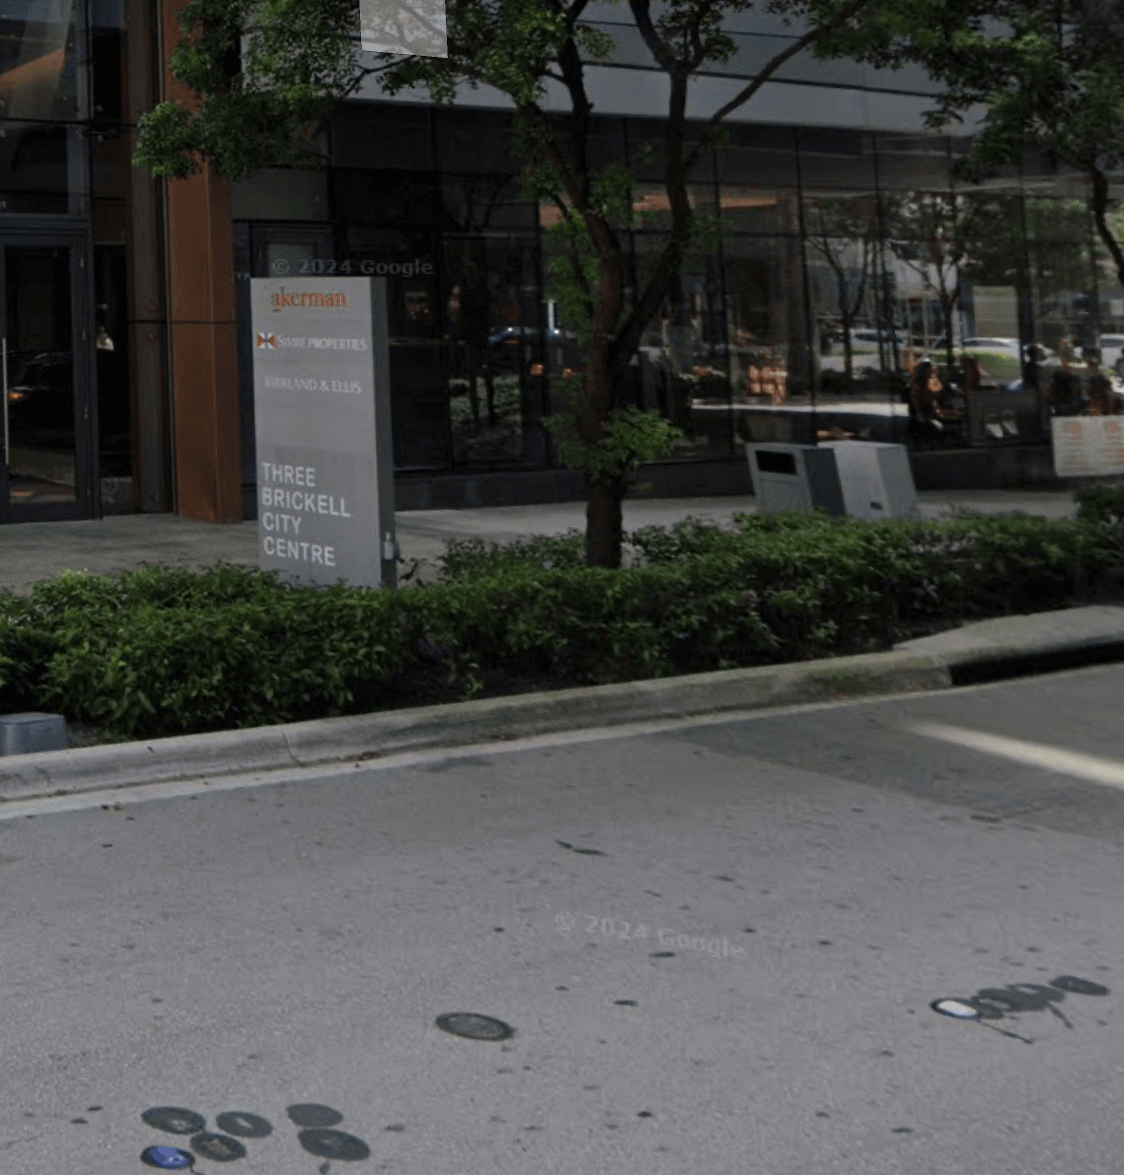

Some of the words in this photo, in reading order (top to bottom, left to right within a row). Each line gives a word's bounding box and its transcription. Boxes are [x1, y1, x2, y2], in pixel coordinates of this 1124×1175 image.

[270, 286, 349, 313] akerman
[308, 337, 367, 351] PROPERTIES
[320, 379, 330, 392] &
[331, 380, 362, 394] ELLIS
[262, 462, 316, 488] THREE
[262, 486, 351, 518] BRICKELL
[262, 511, 303, 535] CITY
[263, 535, 337, 567] CENTRE
